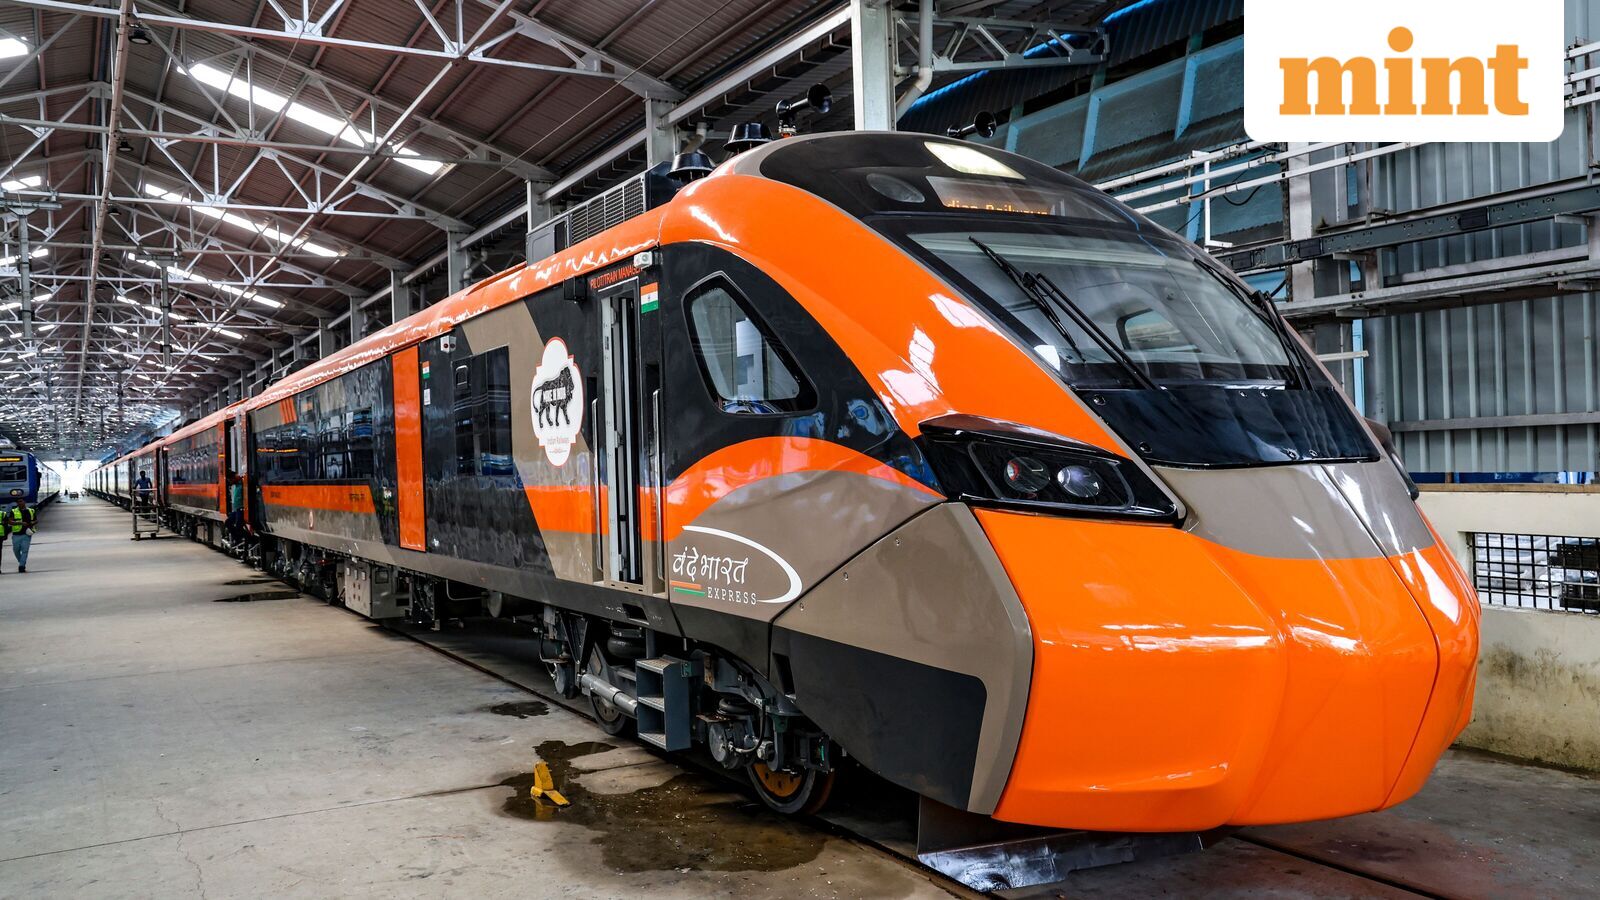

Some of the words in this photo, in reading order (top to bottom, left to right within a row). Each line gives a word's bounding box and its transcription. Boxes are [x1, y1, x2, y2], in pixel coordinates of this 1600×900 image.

[672, 546, 699, 582] वंदे
[700, 554, 749, 585] भारत
[707, 586, 758, 606] EXPRESS
